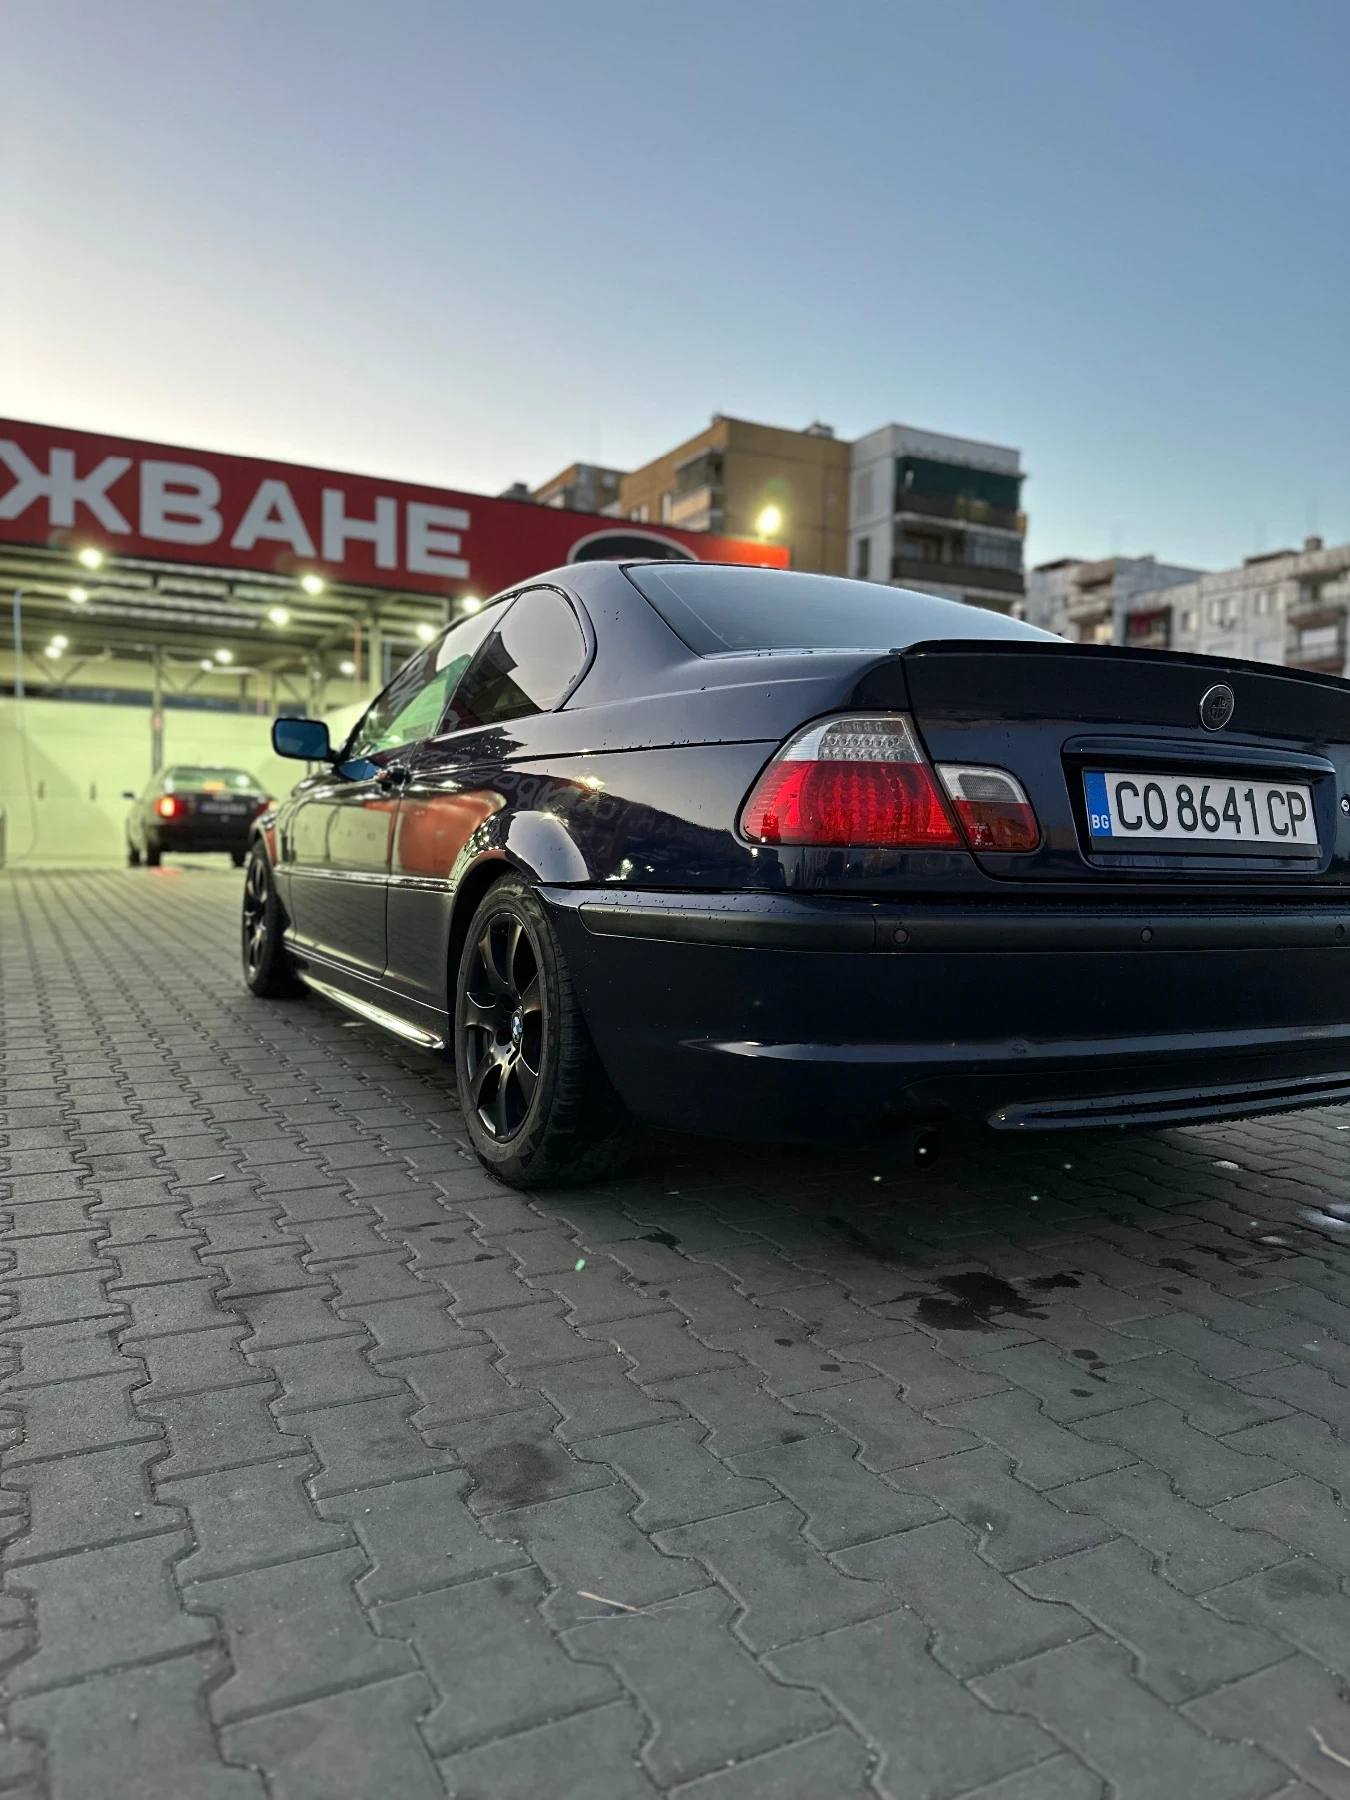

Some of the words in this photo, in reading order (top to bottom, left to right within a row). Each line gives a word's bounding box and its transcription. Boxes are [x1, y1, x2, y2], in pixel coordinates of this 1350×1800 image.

[1091, 814, 1110, 829] BG
[1115, 781, 1169, 831] CO
[1175, 784, 1260, 835] 8641
[1266, 790, 1307, 837] CP
